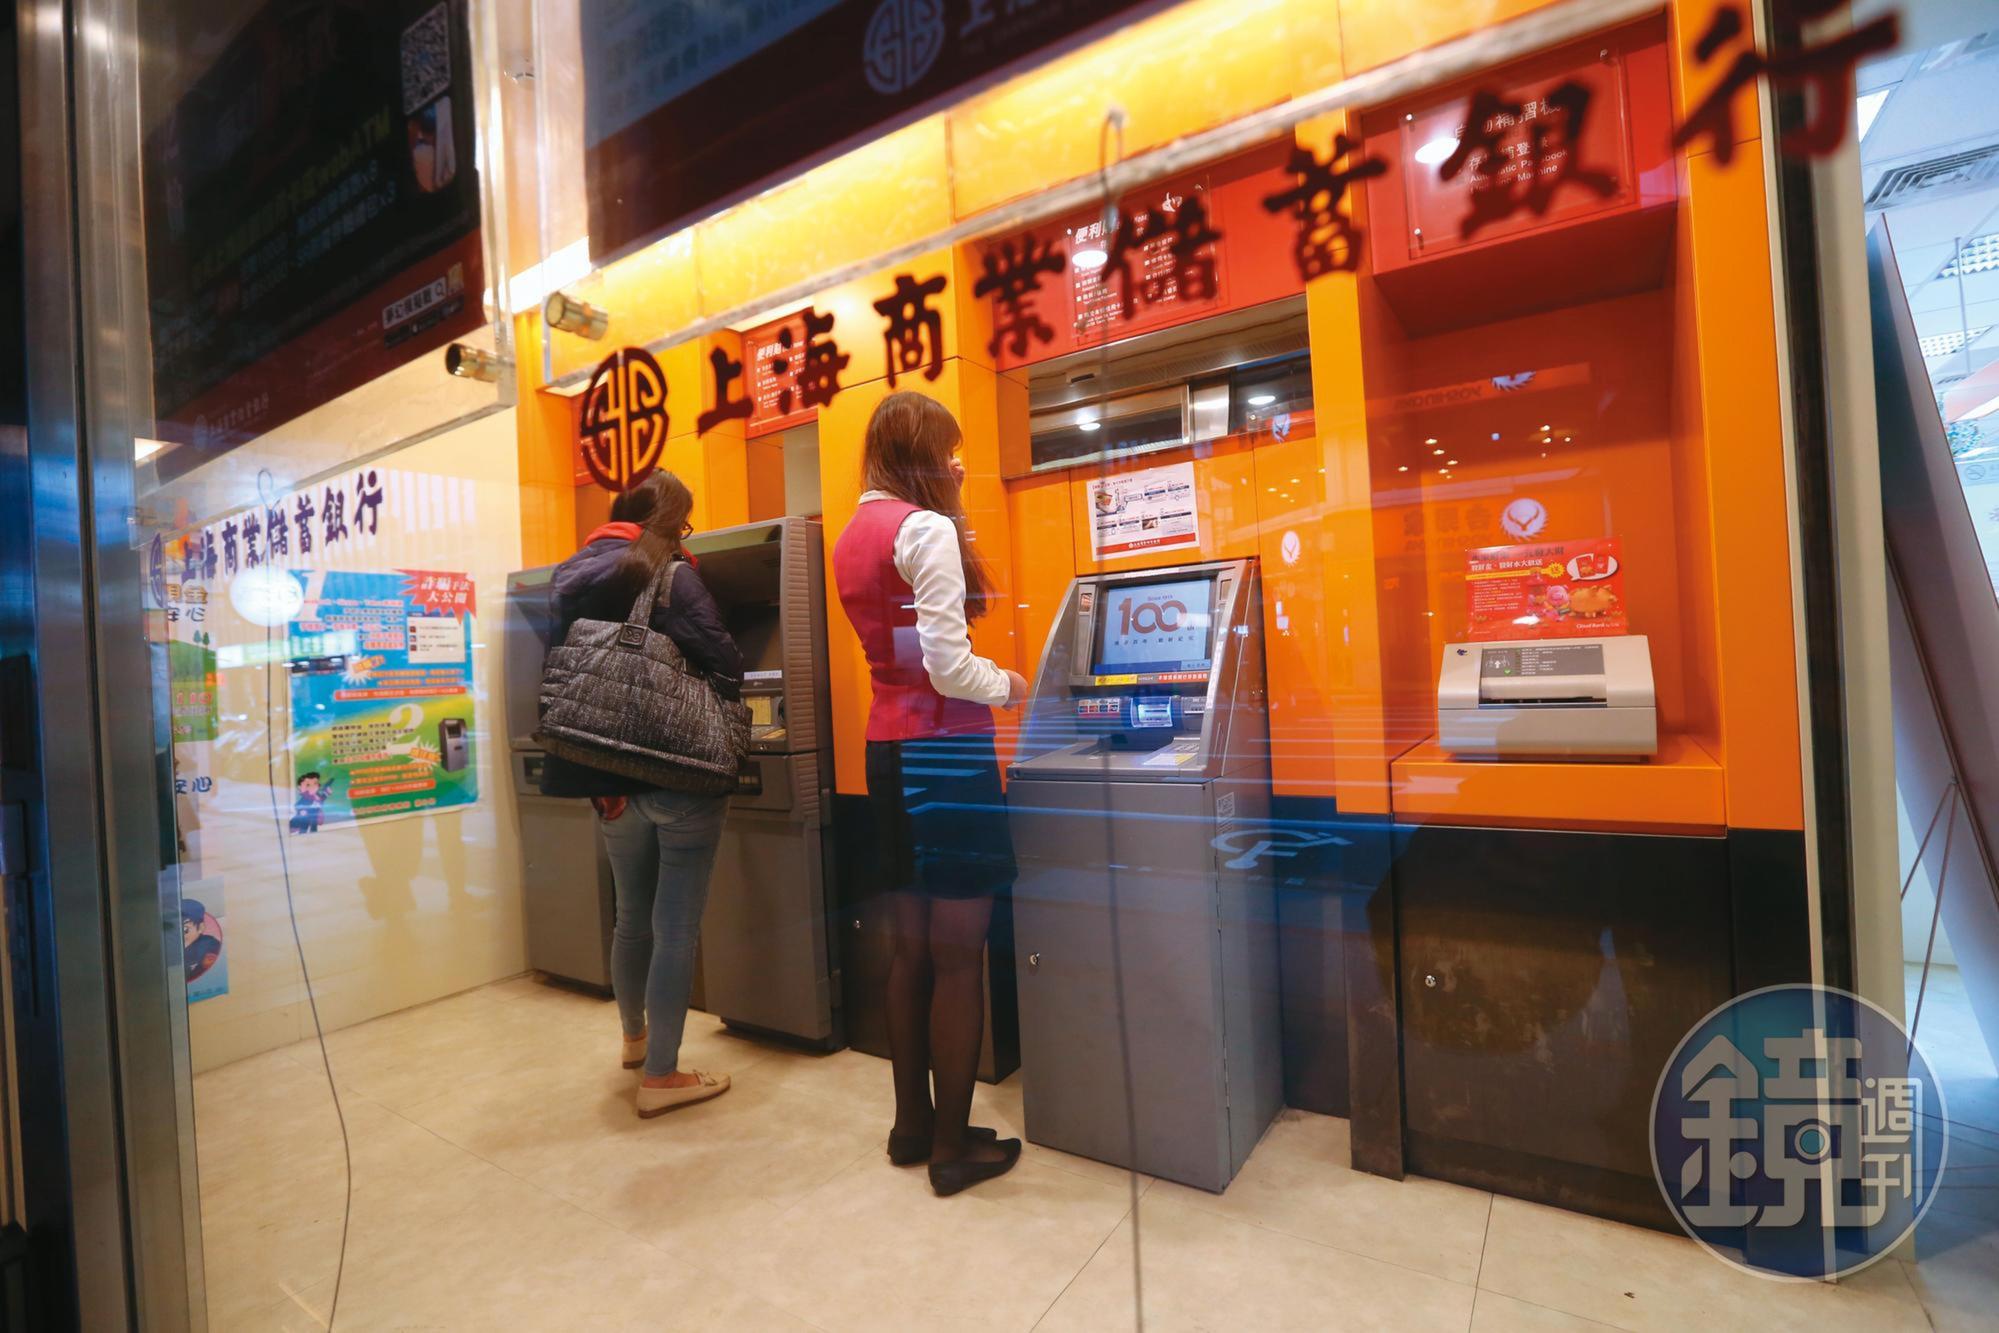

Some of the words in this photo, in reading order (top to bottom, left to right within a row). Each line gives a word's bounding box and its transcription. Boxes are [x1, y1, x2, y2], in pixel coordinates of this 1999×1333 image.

[698, 1, 1901, 438] 上海商業儲蓄銀行
[181, 470, 383, 587] 上海商業儲蓄銀行
[1118, 597, 1187, 636] 100
